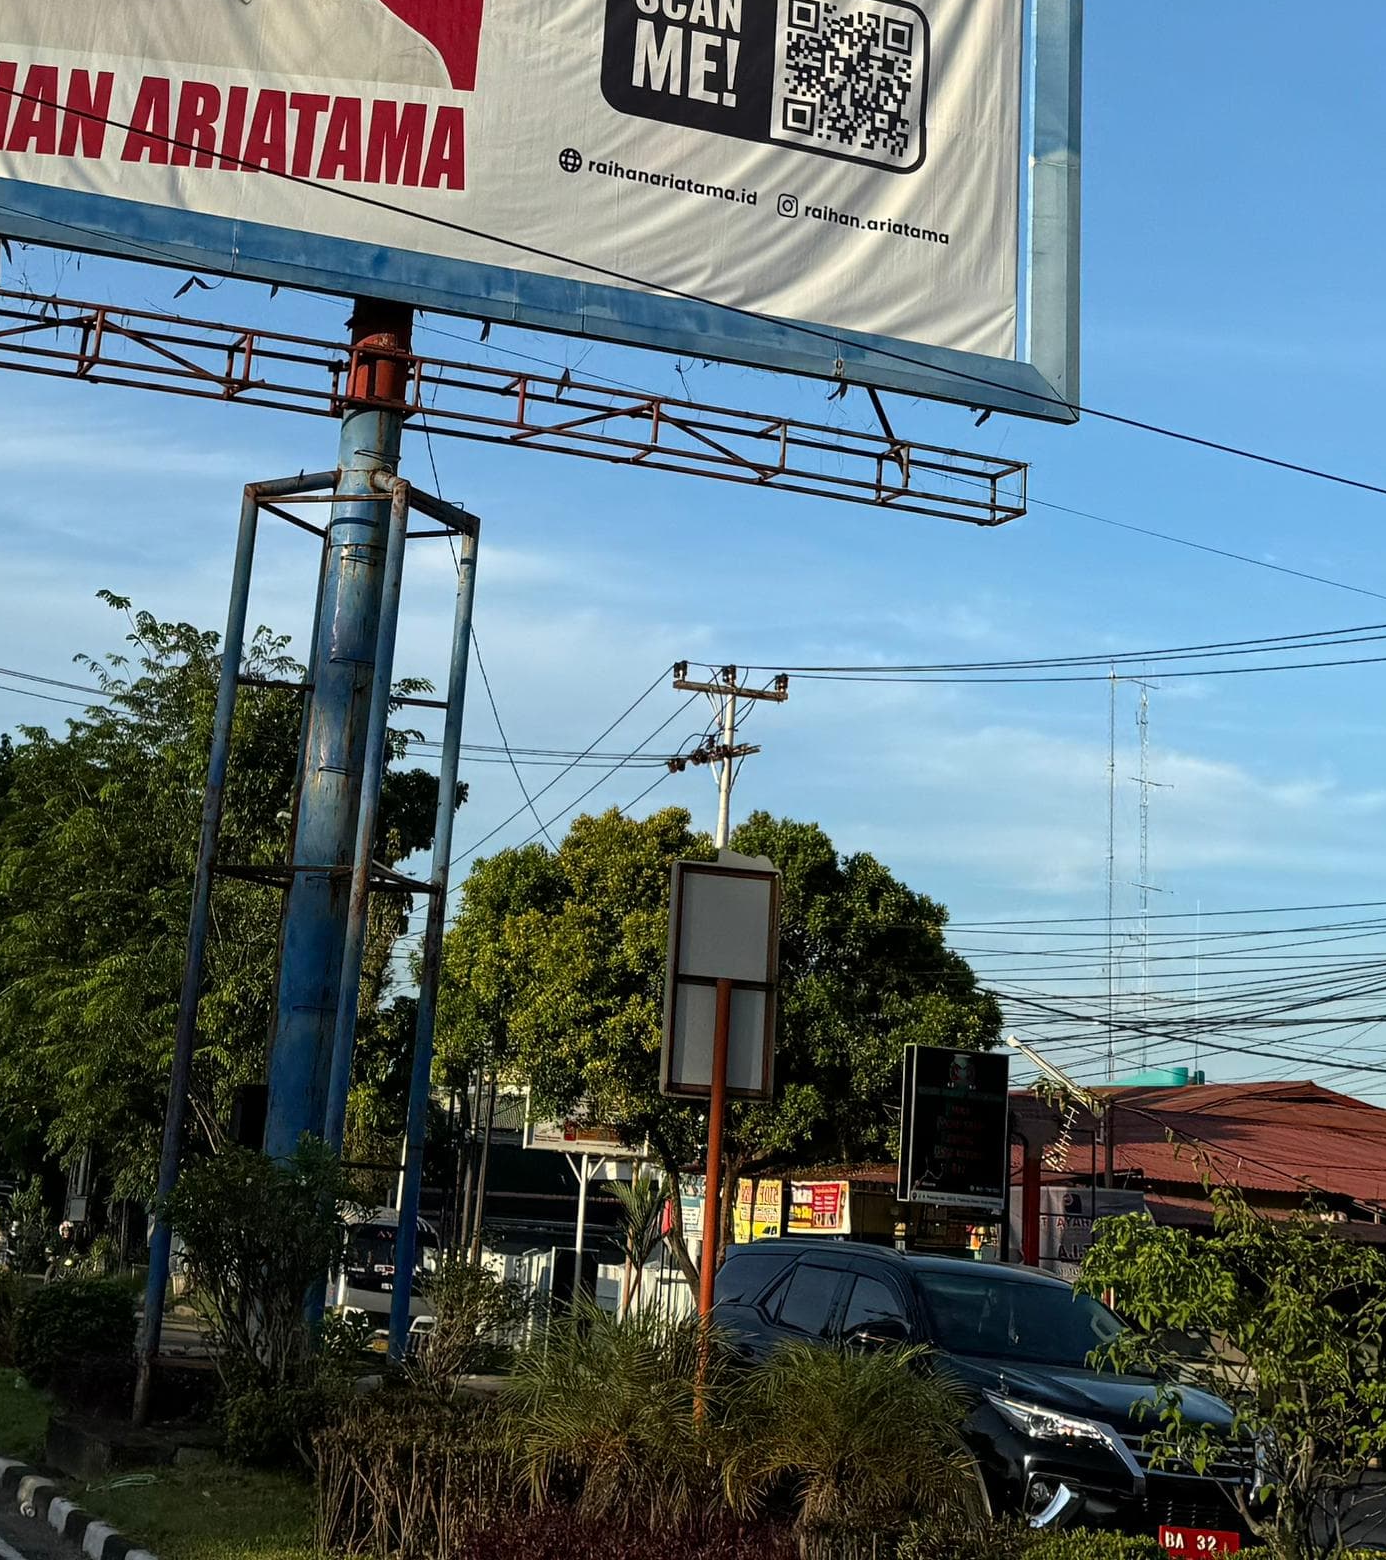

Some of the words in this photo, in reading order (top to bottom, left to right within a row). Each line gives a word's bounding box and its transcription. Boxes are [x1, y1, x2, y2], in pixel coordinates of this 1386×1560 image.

[631, 18, 741, 109] ME!
[121, 75, 466, 191] ARIATAMA
[588, 156, 758, 207] raihanariatama.id
[804, 203, 950, 245] raihan.ariatama
[1165, 1531, 1184, 1549] BA
